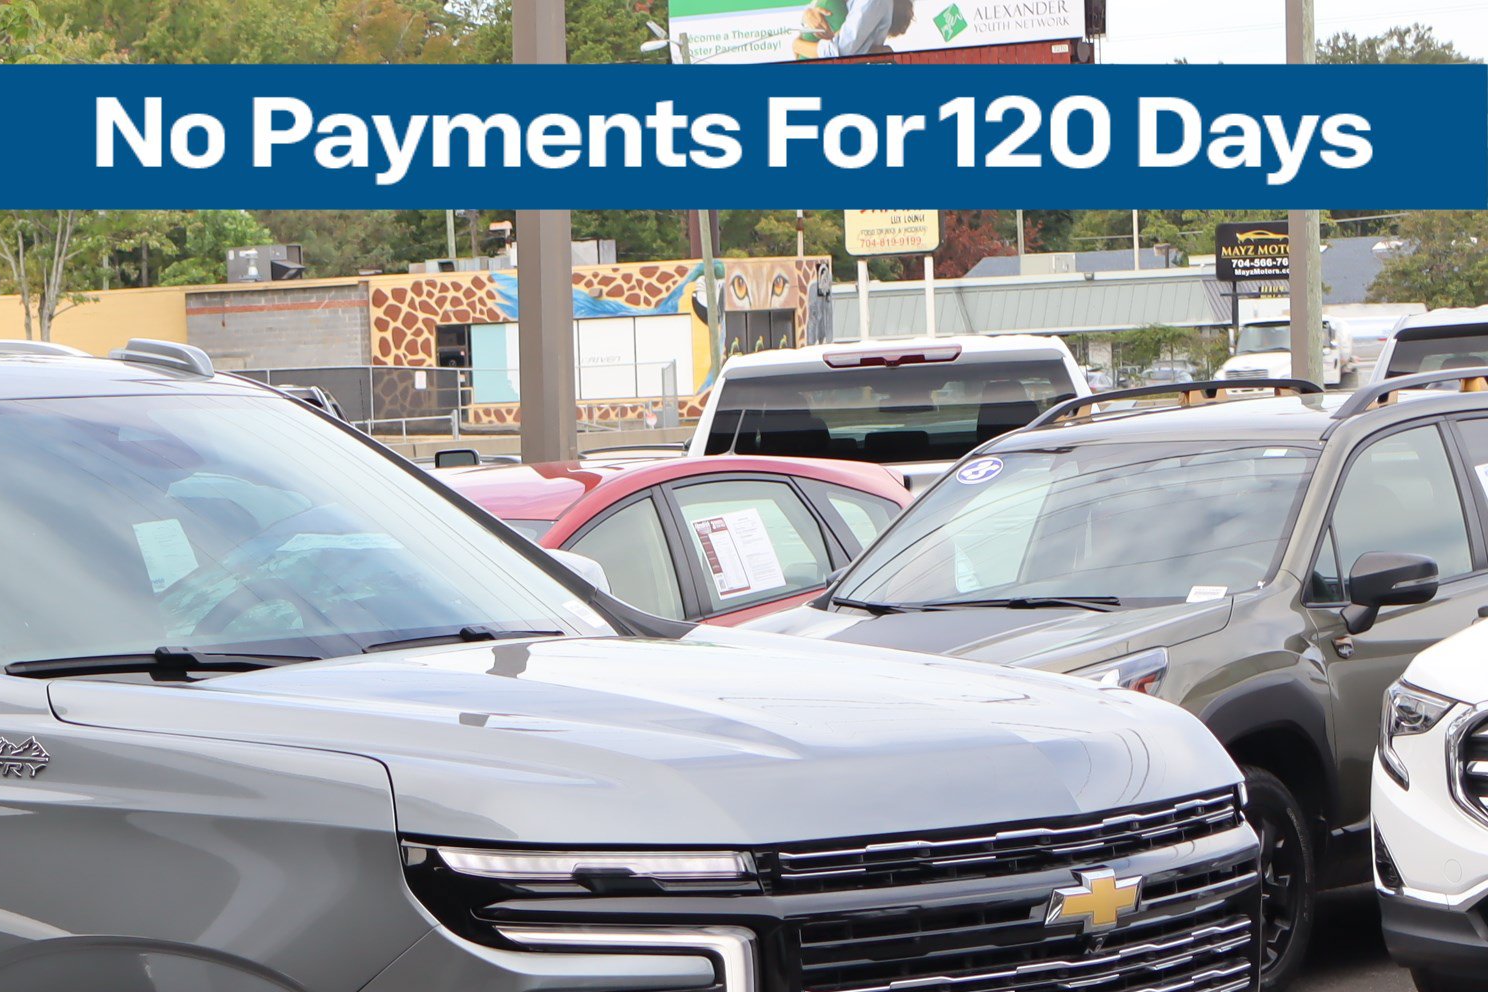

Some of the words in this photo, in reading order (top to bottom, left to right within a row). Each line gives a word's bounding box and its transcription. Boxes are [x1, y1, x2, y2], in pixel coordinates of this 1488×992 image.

[973, 0, 1069, 20] ALEXANDER
[974, 20, 1011, 33] YOUTH
[1015, 16, 1070, 30] NETWORK
[687, 32, 722, 43] ecome
[731, 26, 792, 39] Therapeutic
[687, 47, 712, 56] oster
[715, 43, 748, 54] Parent
[750, 40, 782, 53] today!
[891, 215, 902, 224] LUX
[1222, 245, 1255, 256] MAYZ
